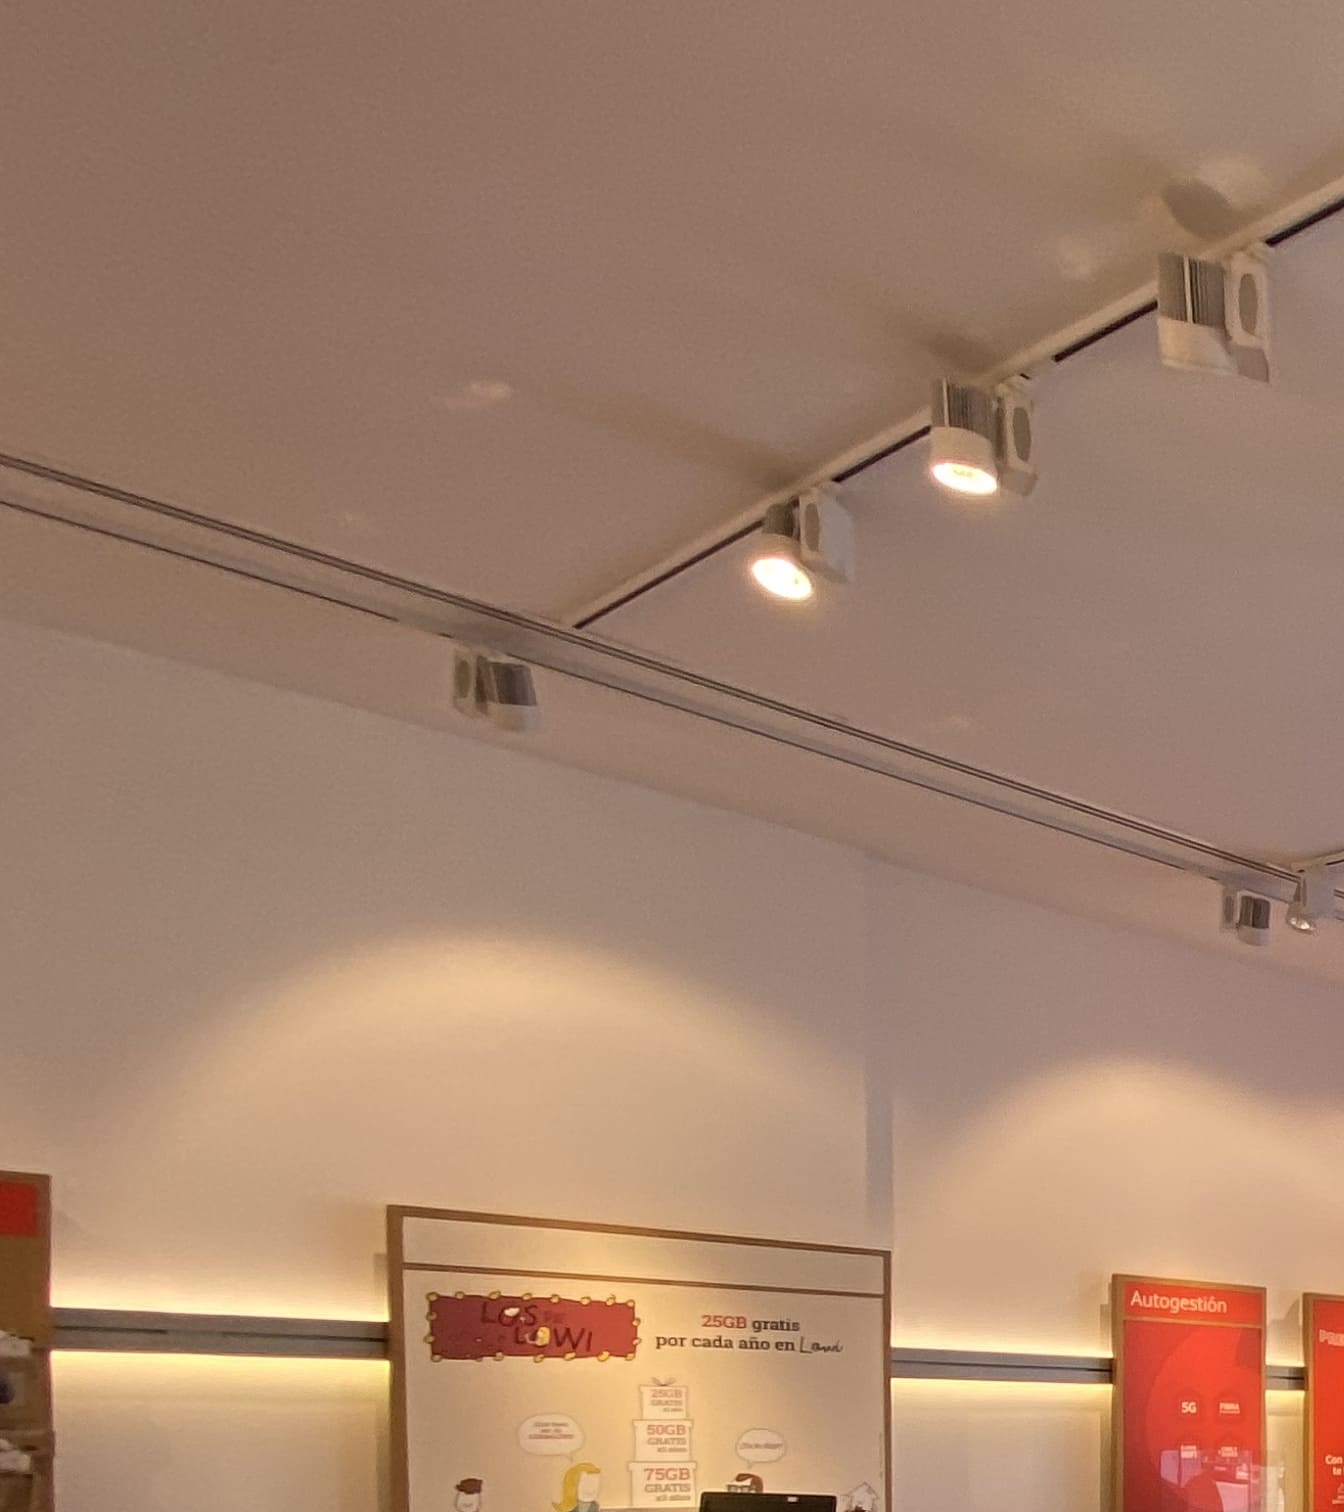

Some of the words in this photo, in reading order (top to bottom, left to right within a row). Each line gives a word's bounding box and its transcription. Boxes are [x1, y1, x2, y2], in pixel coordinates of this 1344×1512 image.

[1130, 1290, 1228, 1314] Autogestión
[701, 1314, 747, 1329] 25GB
[752, 1318, 800, 1333] gratis
[655, 1335, 687, 1350] por
[691, 1335, 734, 1349] cada
[738, 1336, 770, 1351] año
[775, 1340, 795, 1351] en
[1181, 1401, 1197, 1414] 5G
[646, 1423, 687, 1436] 50GB
[1325, 1455, 1343, 1464] Con
[643, 1467, 691, 1481] 75GB
